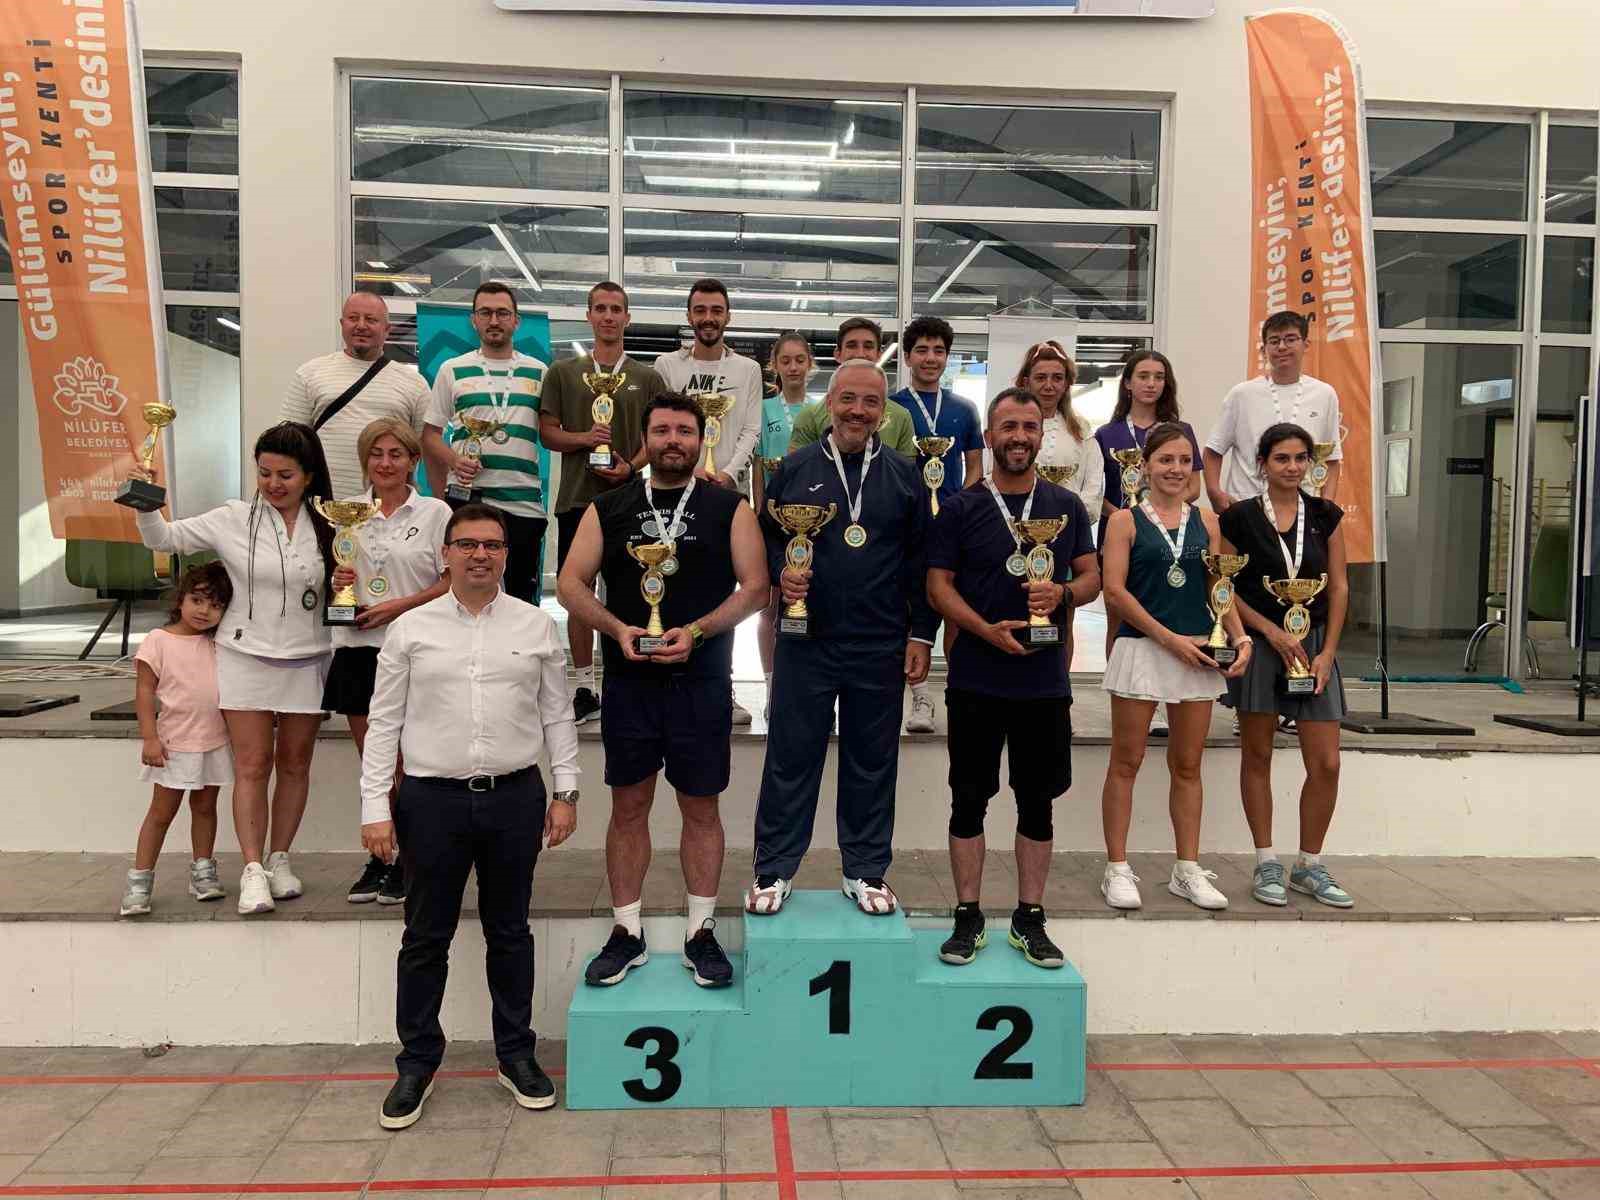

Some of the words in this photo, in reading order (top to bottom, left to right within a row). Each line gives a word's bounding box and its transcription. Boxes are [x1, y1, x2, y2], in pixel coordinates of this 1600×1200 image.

[45, 172, 73, 263] SPOR
[809, 960, 851, 1035] 1
[622, 1026, 682, 1103] 3
[973, 1006, 1034, 1079] 2
